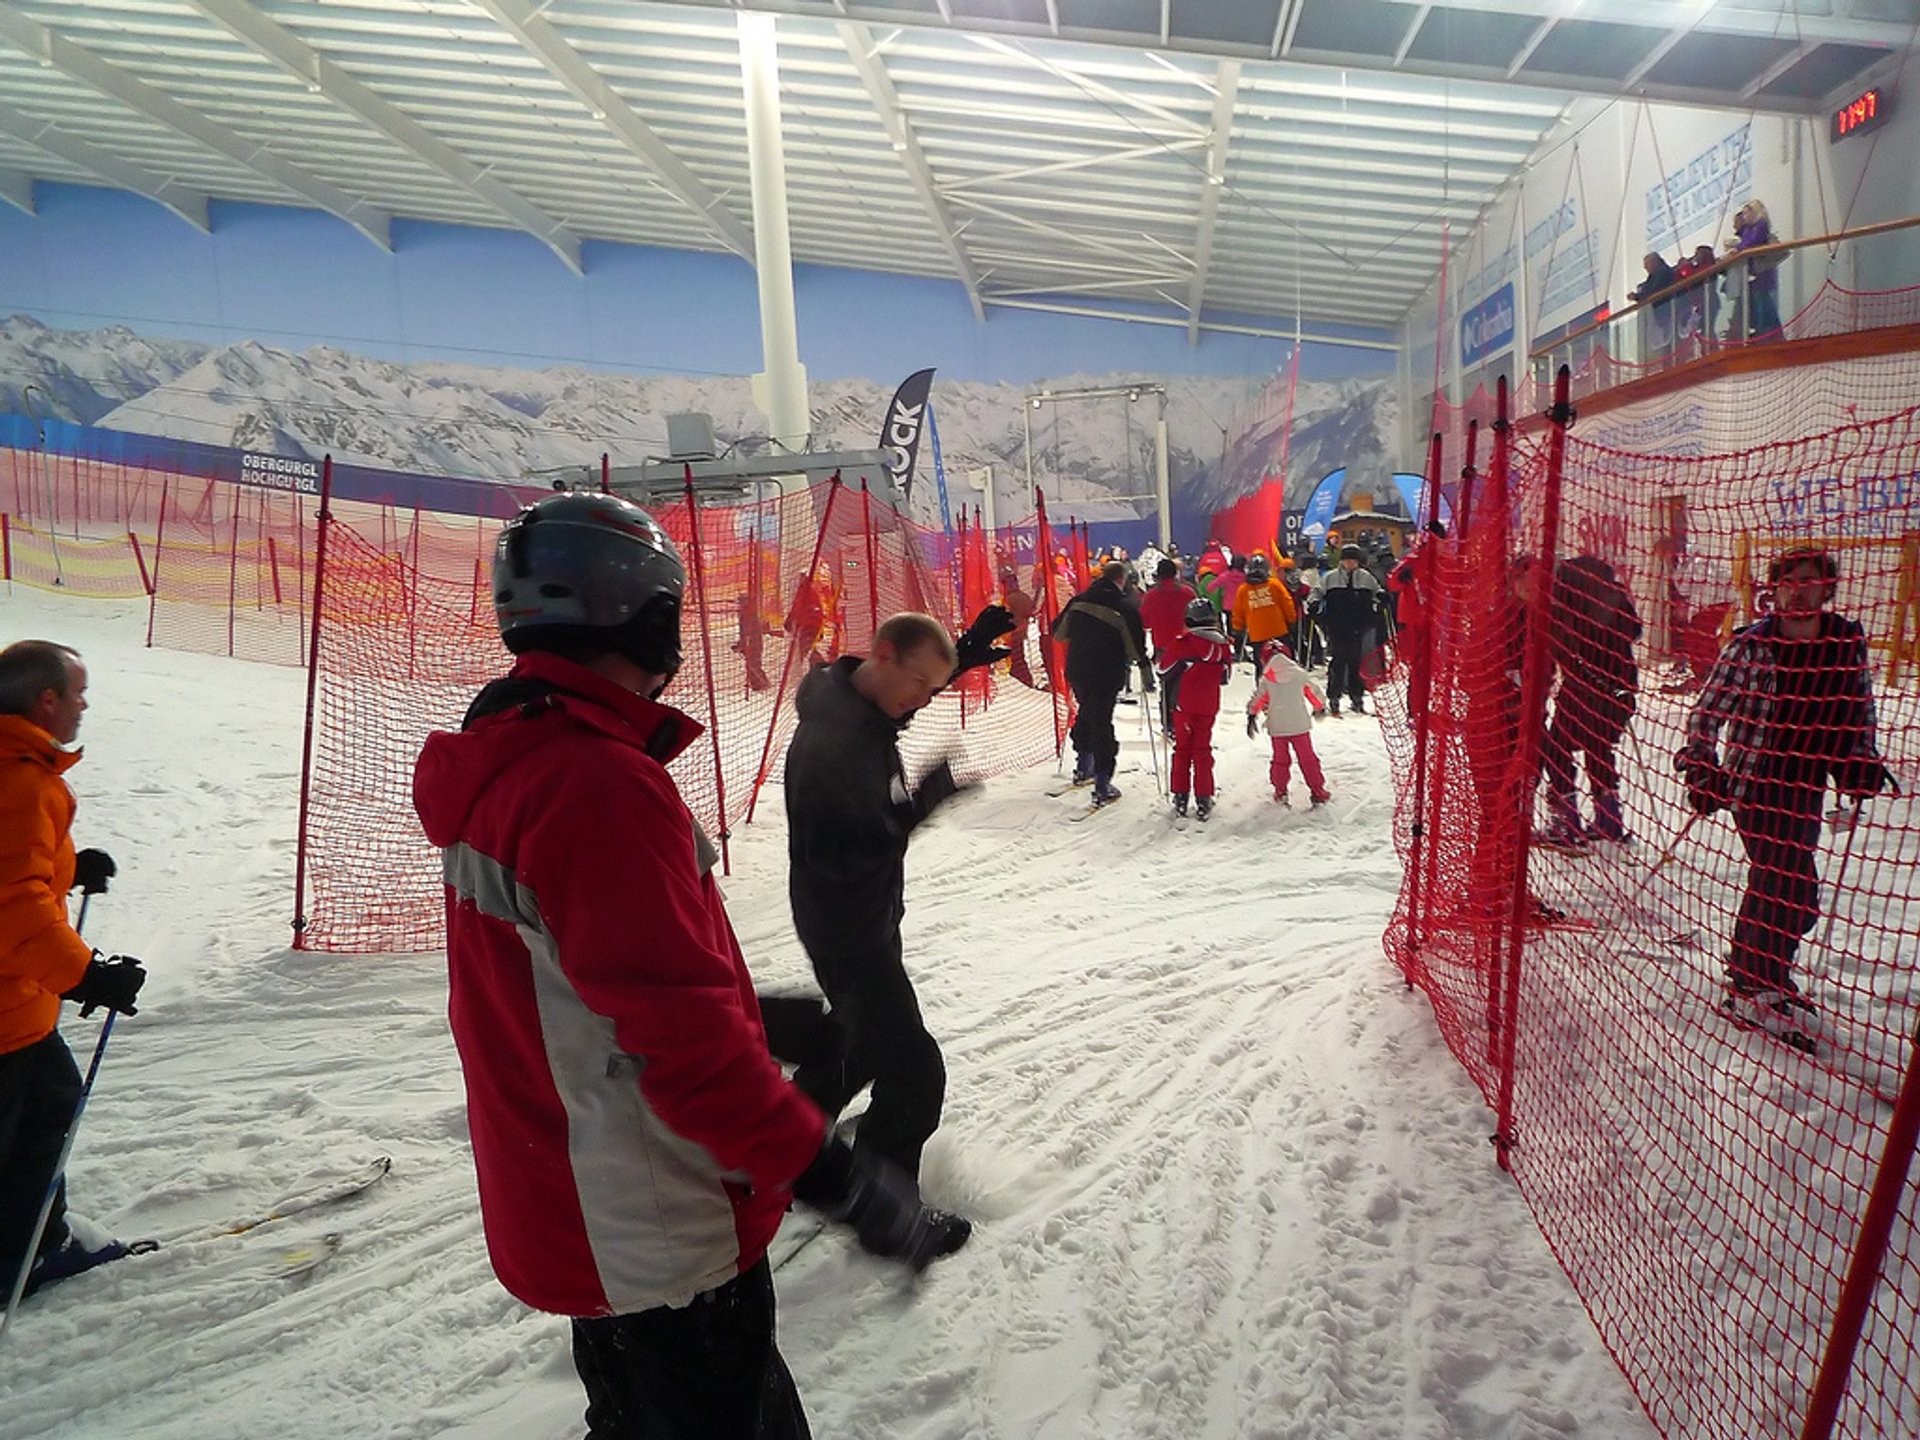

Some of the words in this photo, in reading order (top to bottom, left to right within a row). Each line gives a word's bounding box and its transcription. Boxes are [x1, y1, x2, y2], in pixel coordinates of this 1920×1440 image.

[1472, 301, 1512, 348] Columbia
[241, 468, 318, 492] HOCHGURGL
[242, 454, 319, 477] OBERGURGL
[1772, 477, 1844, 516] WE
